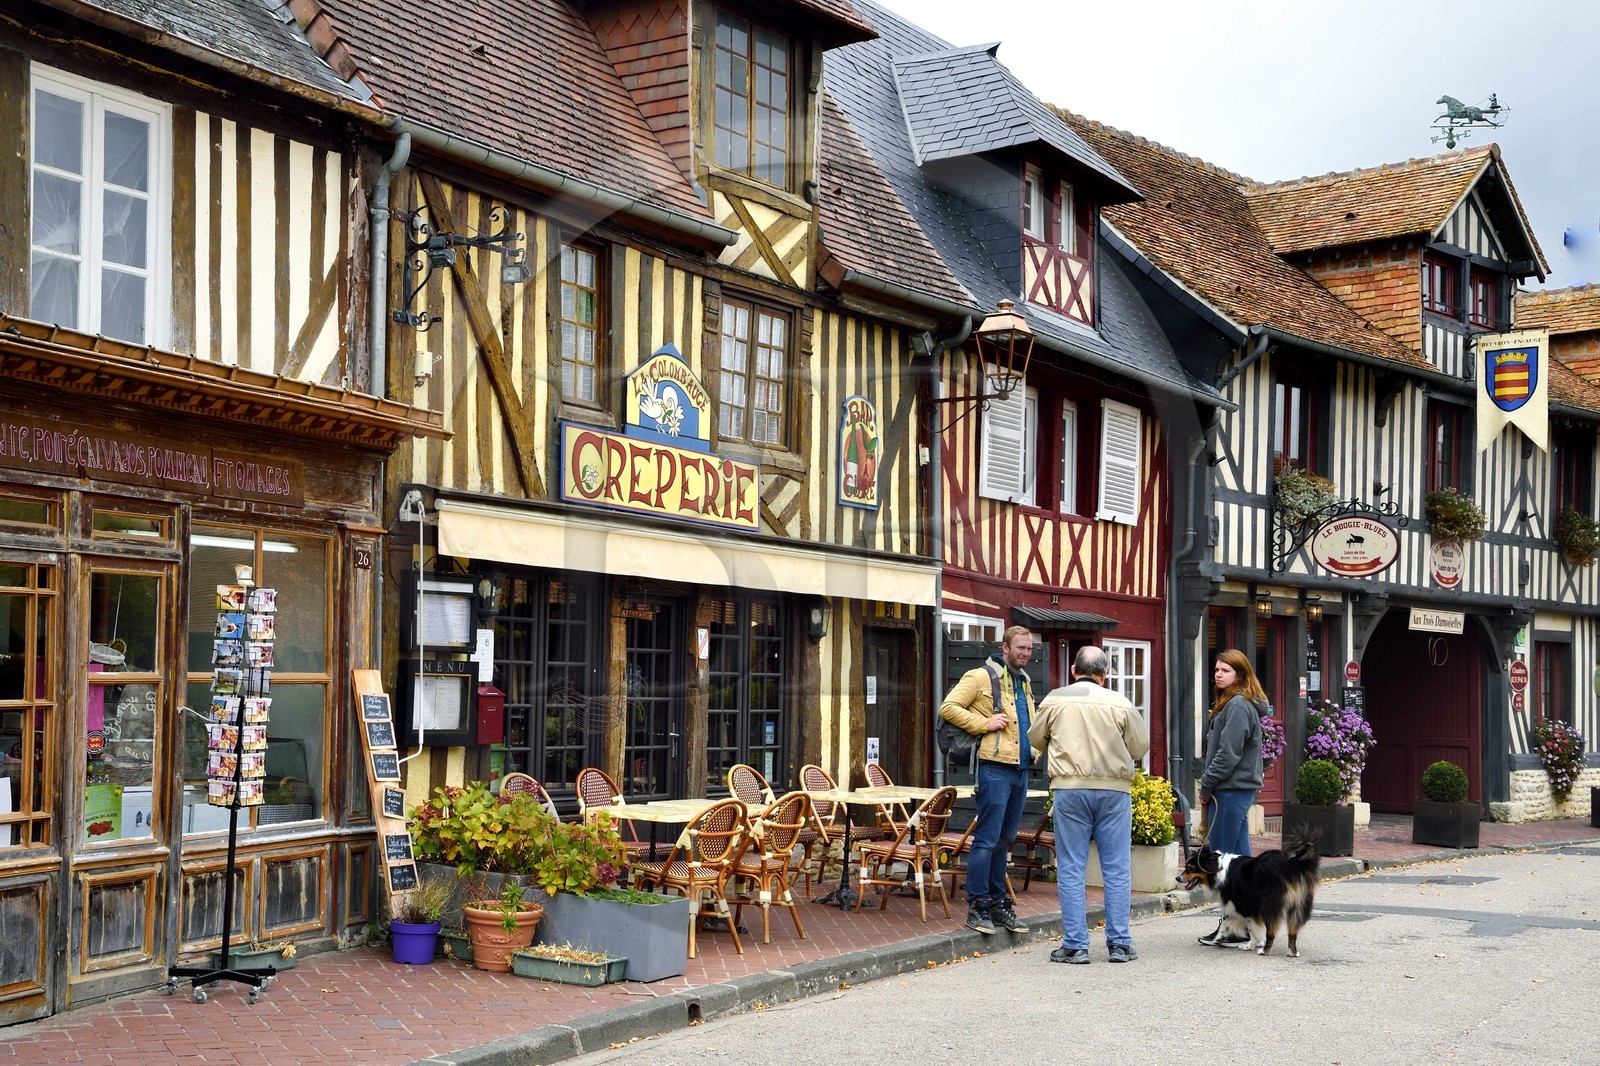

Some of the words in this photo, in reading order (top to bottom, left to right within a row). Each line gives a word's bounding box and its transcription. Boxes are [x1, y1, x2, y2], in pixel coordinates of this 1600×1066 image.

[846, 400, 875, 433] BAR
[357, 551, 369, 566] 26
[886, 606, 894, 617] 24
[424, 661, 465, 673] MENU
